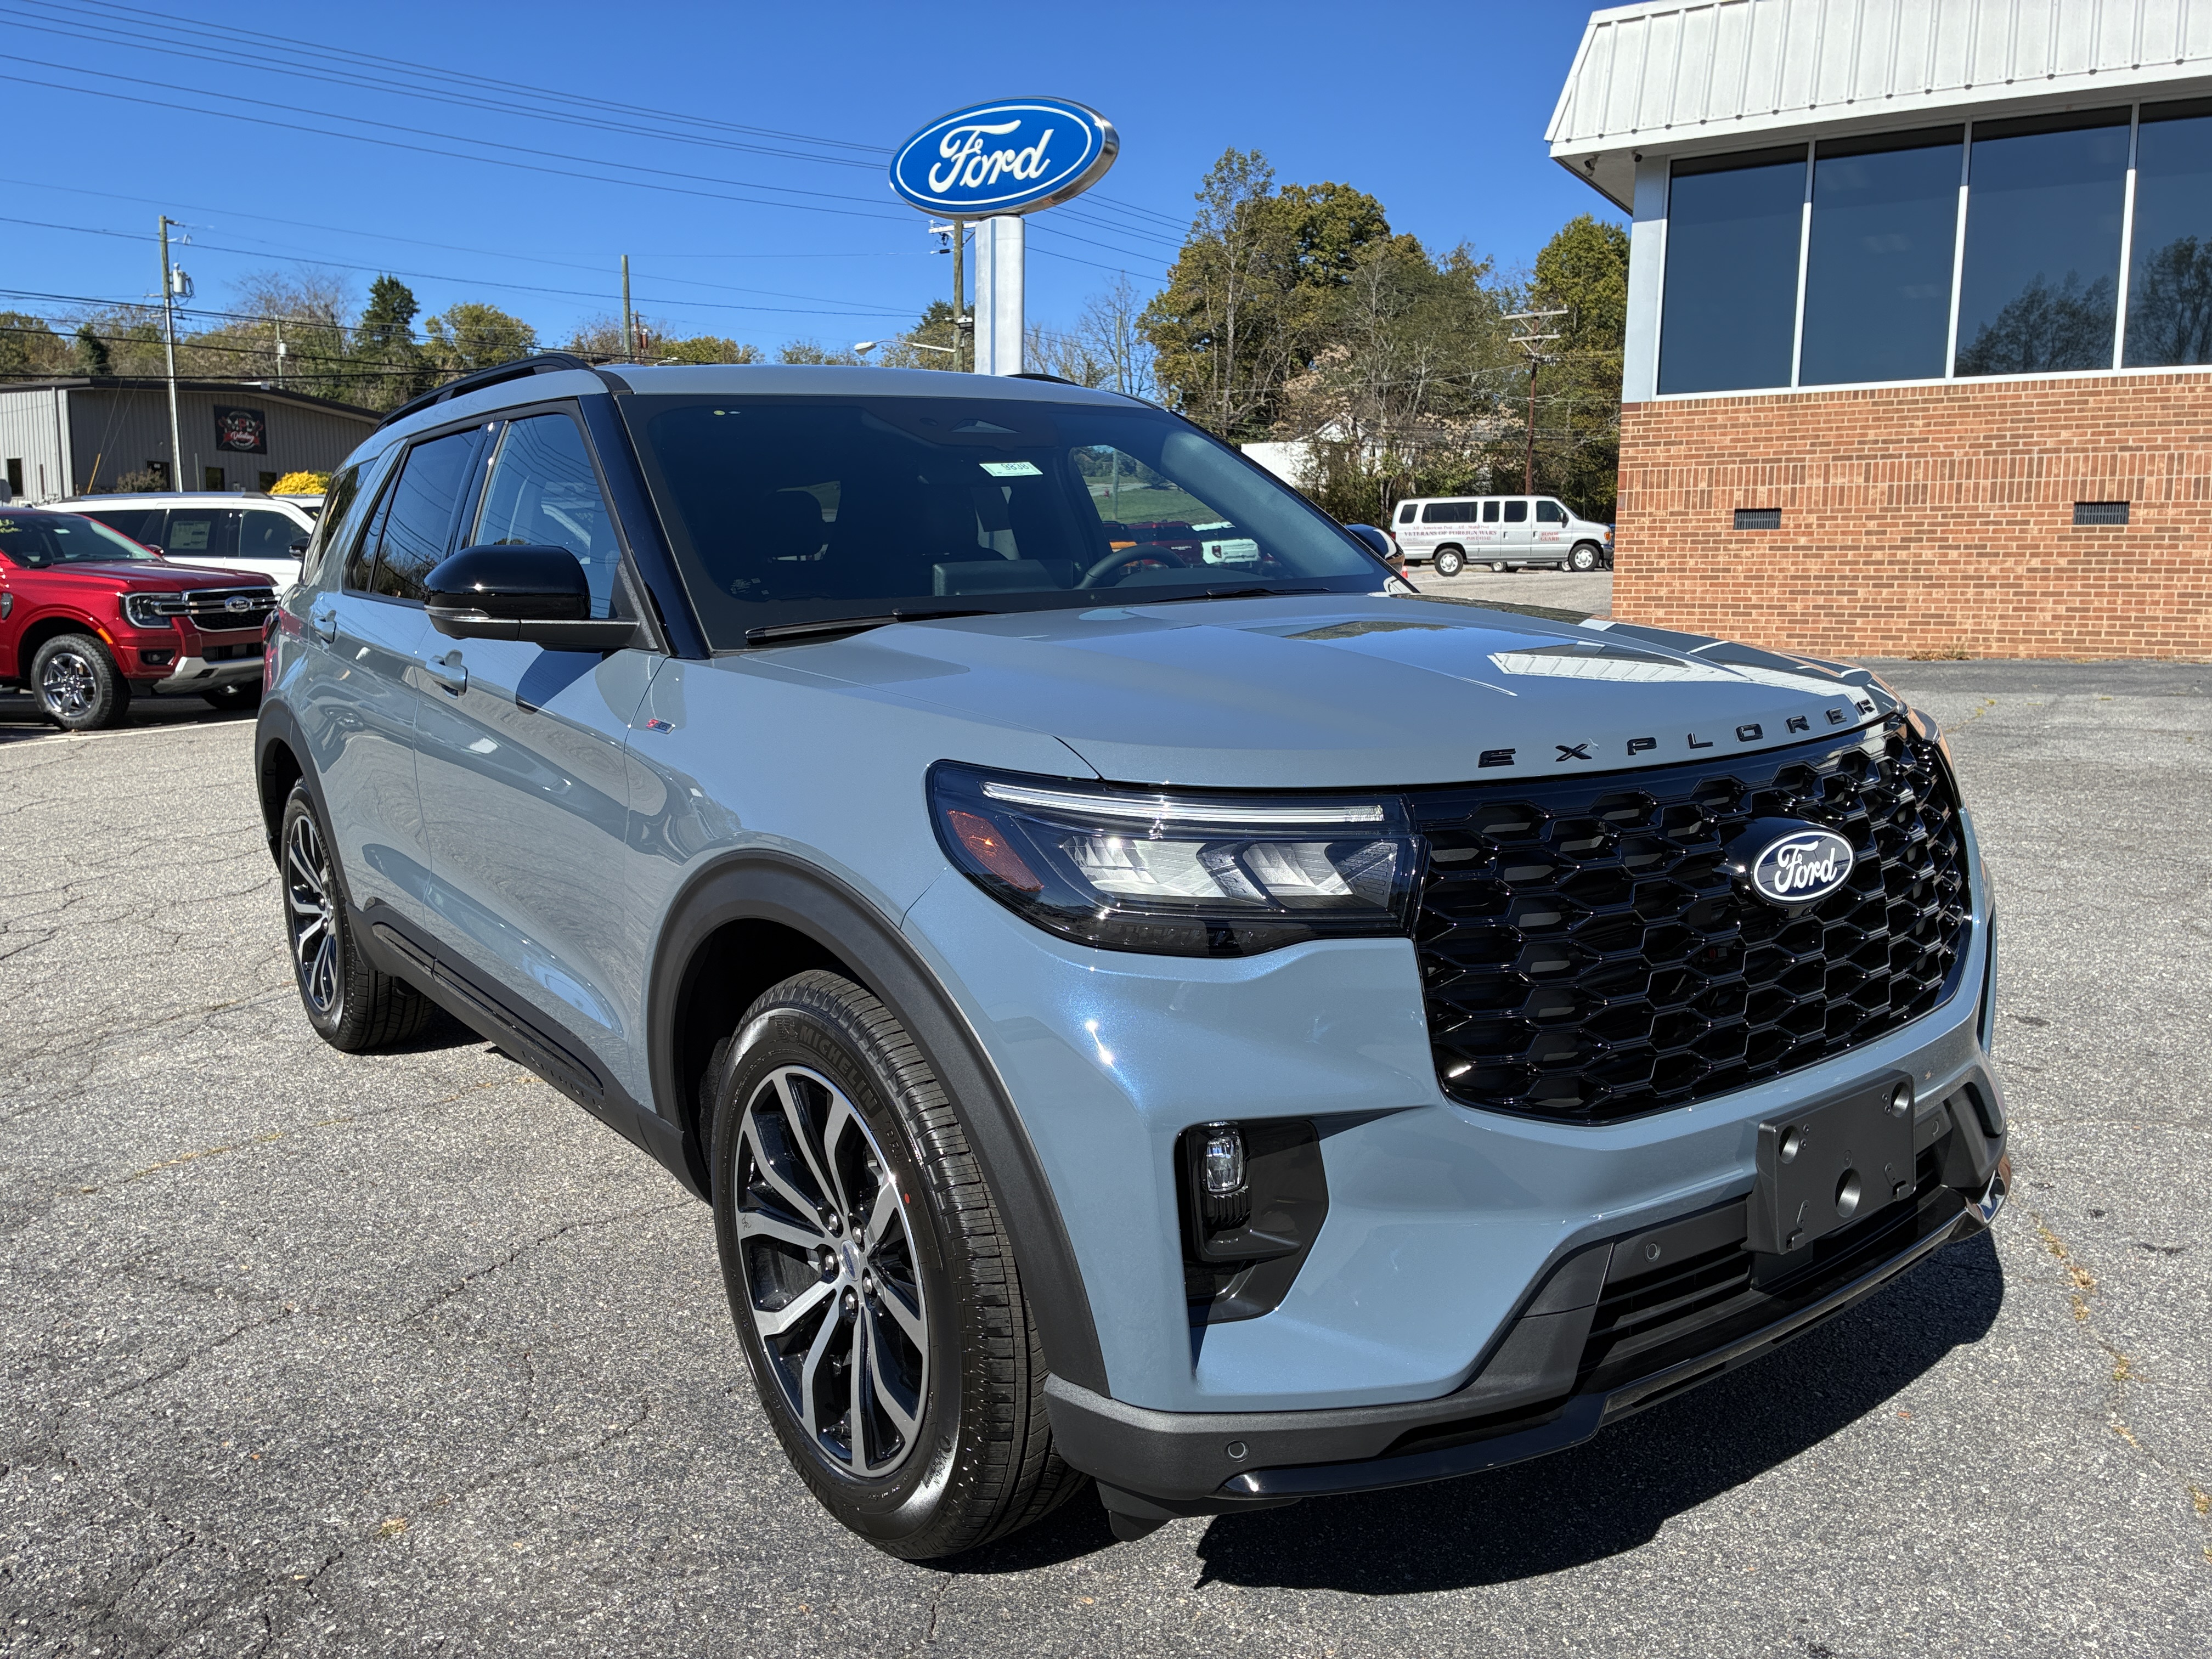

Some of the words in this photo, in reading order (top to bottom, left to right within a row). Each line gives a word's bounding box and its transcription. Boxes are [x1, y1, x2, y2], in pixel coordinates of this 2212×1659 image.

[928, 119, 1054, 193] Ford
[1477, 698, 1875, 769] EXPLORER
[1774, 840, 1838, 893] Ford
[798, 1024, 879, 1113] MICHELIN
